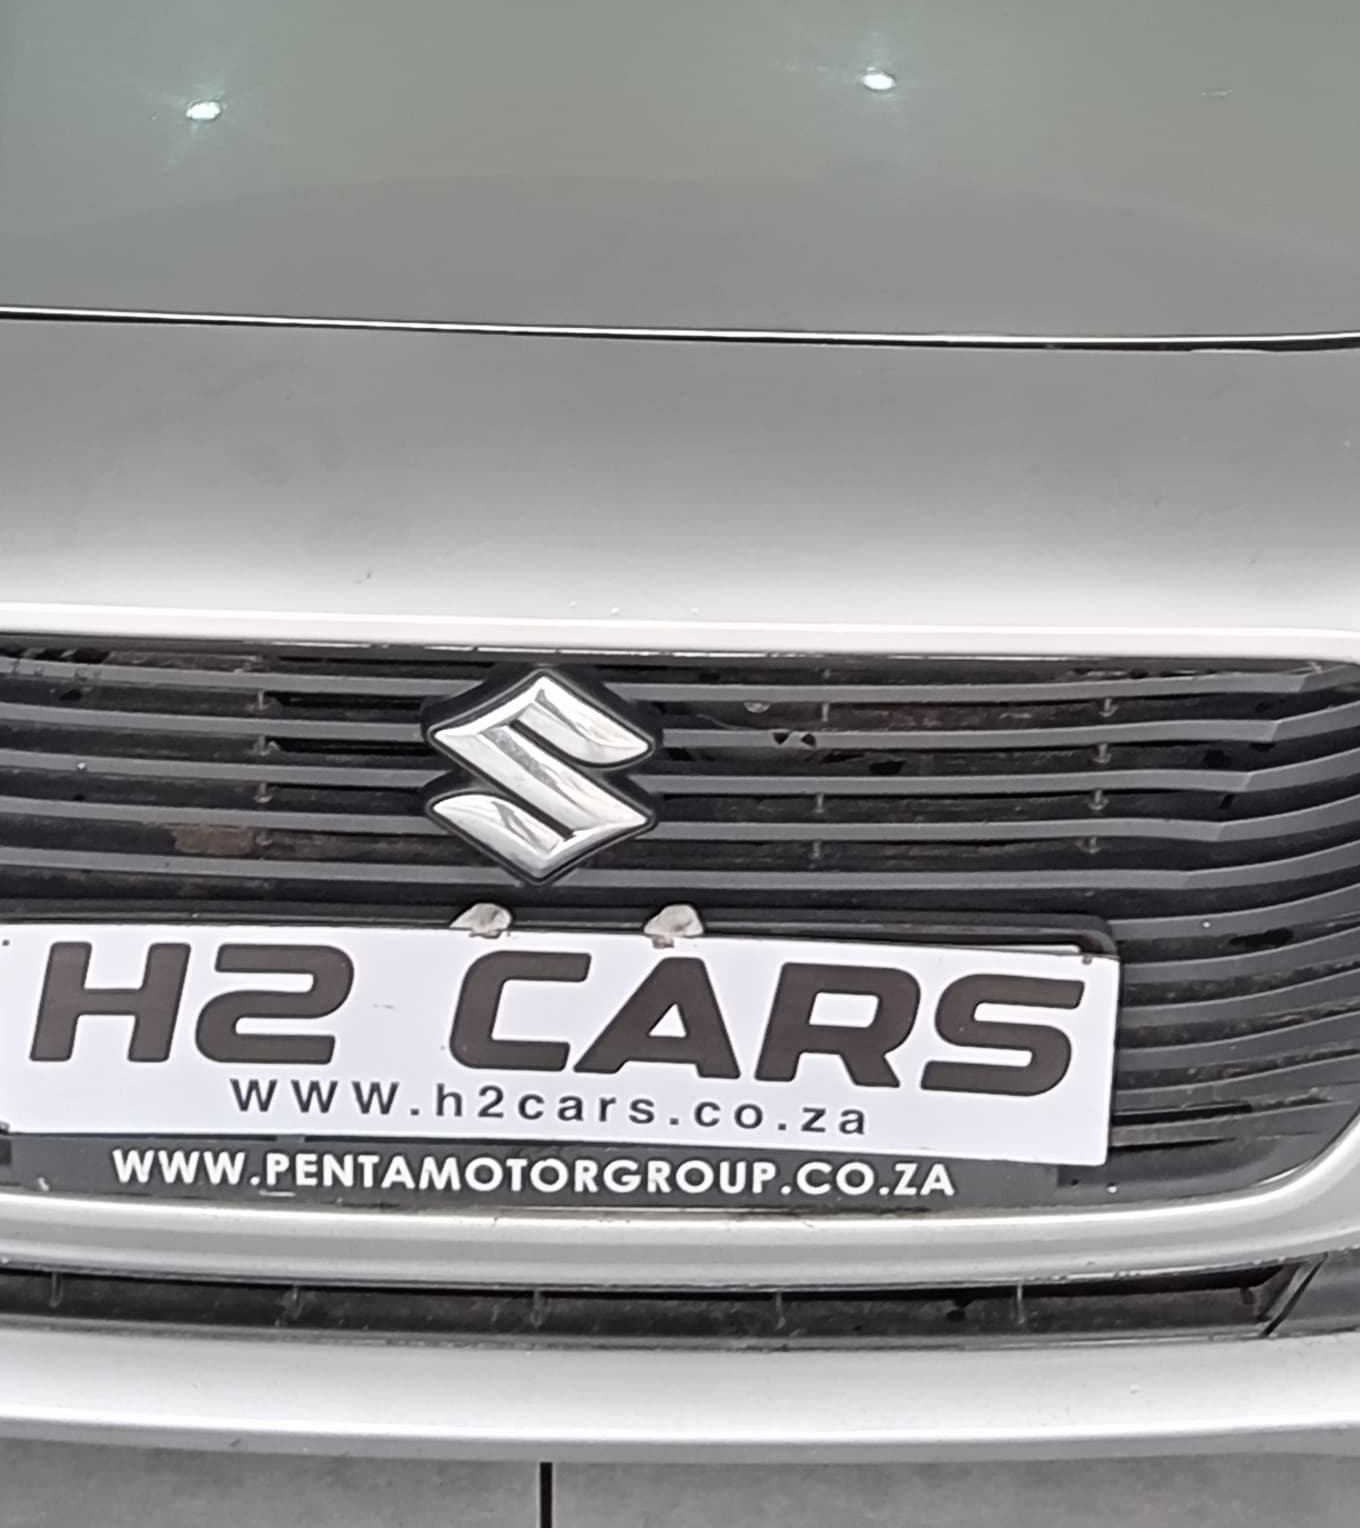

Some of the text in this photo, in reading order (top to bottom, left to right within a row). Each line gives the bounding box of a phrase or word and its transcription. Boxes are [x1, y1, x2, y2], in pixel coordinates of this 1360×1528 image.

[28, 941, 1086, 1098] H2 CARS
[112, 1149, 957, 1197] WWW.PENTAMOTORGROUP.CO.ZA
